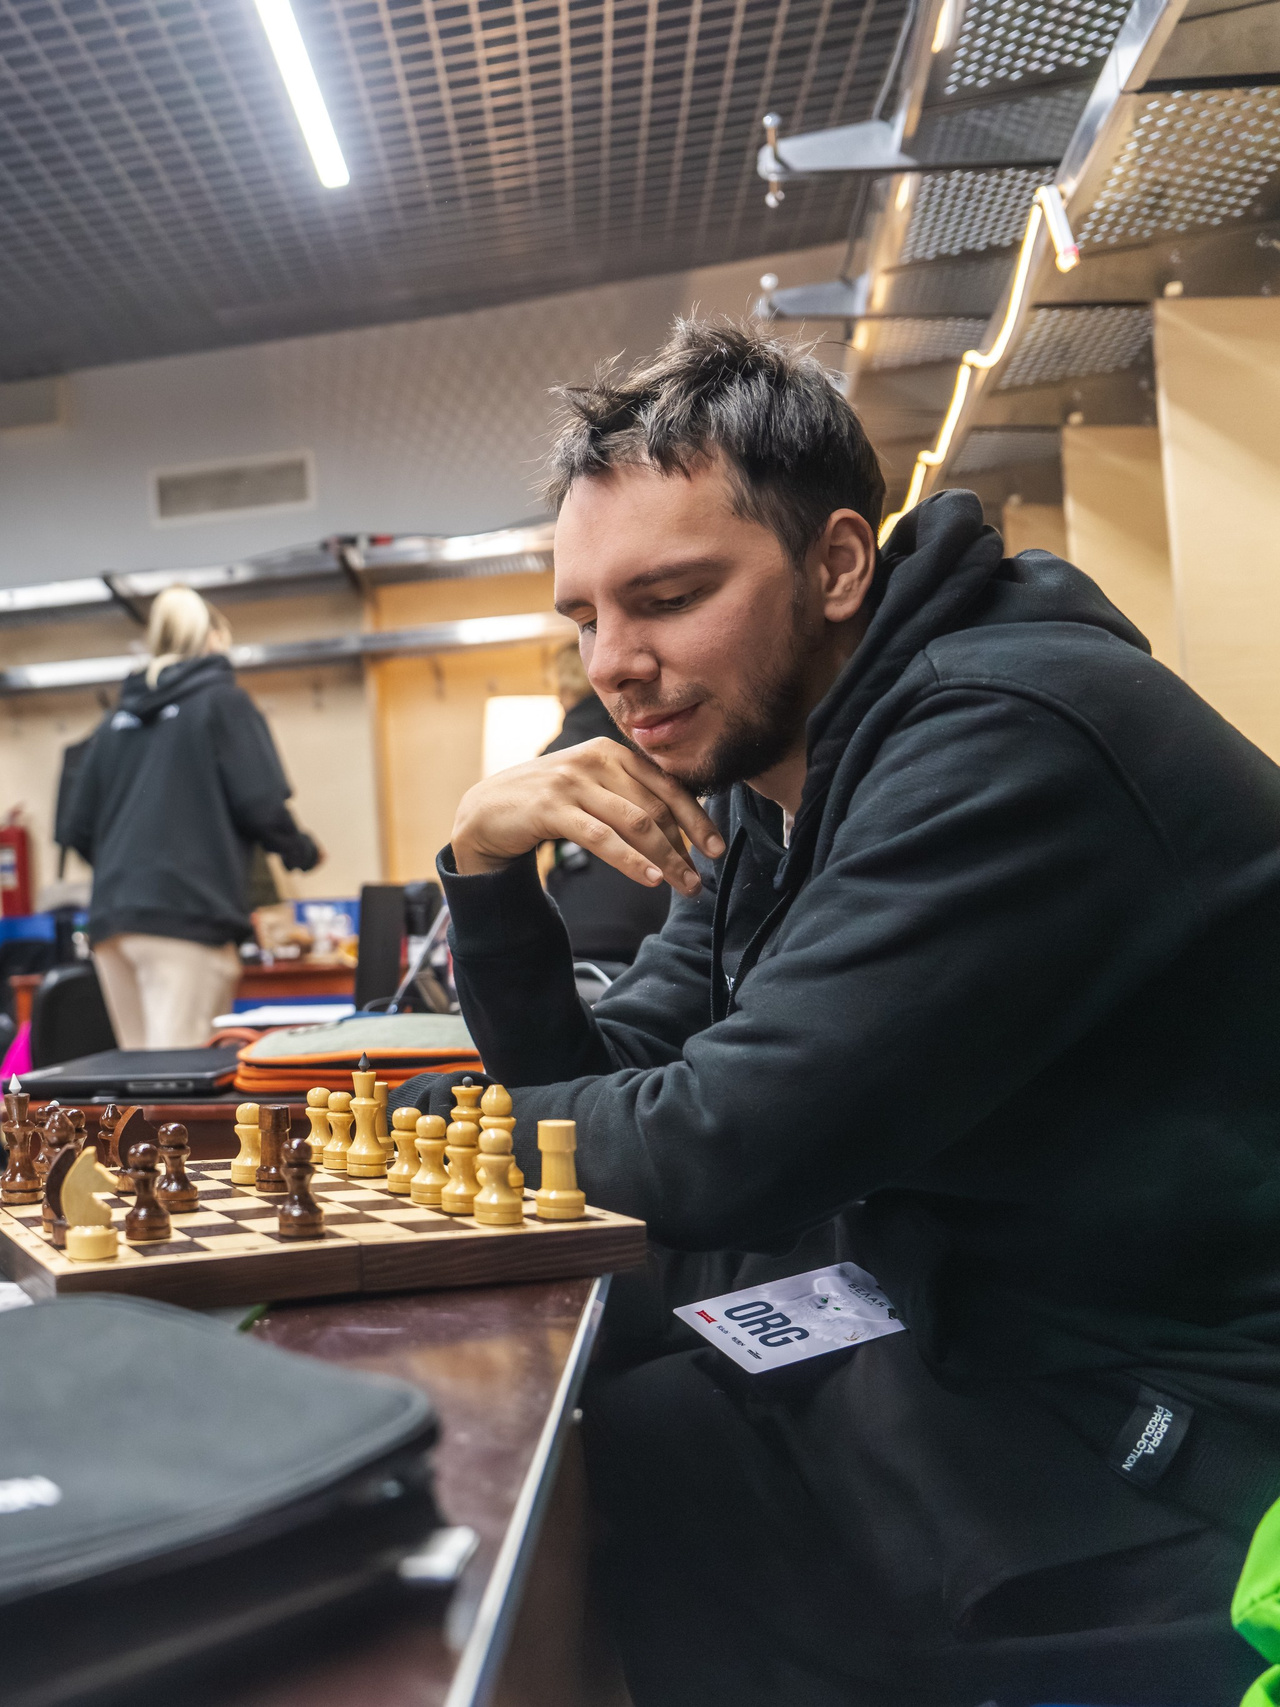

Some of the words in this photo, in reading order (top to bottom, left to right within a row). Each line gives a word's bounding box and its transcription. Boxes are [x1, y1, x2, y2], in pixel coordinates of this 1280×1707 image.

[848, 1283, 887, 1307] БЕЛАЯ
[724, 1301, 809, 1347] ORG
[1121, 1404, 1165, 1472] PRODUCTION
[1144, 1408, 1174, 1455] AURORA
